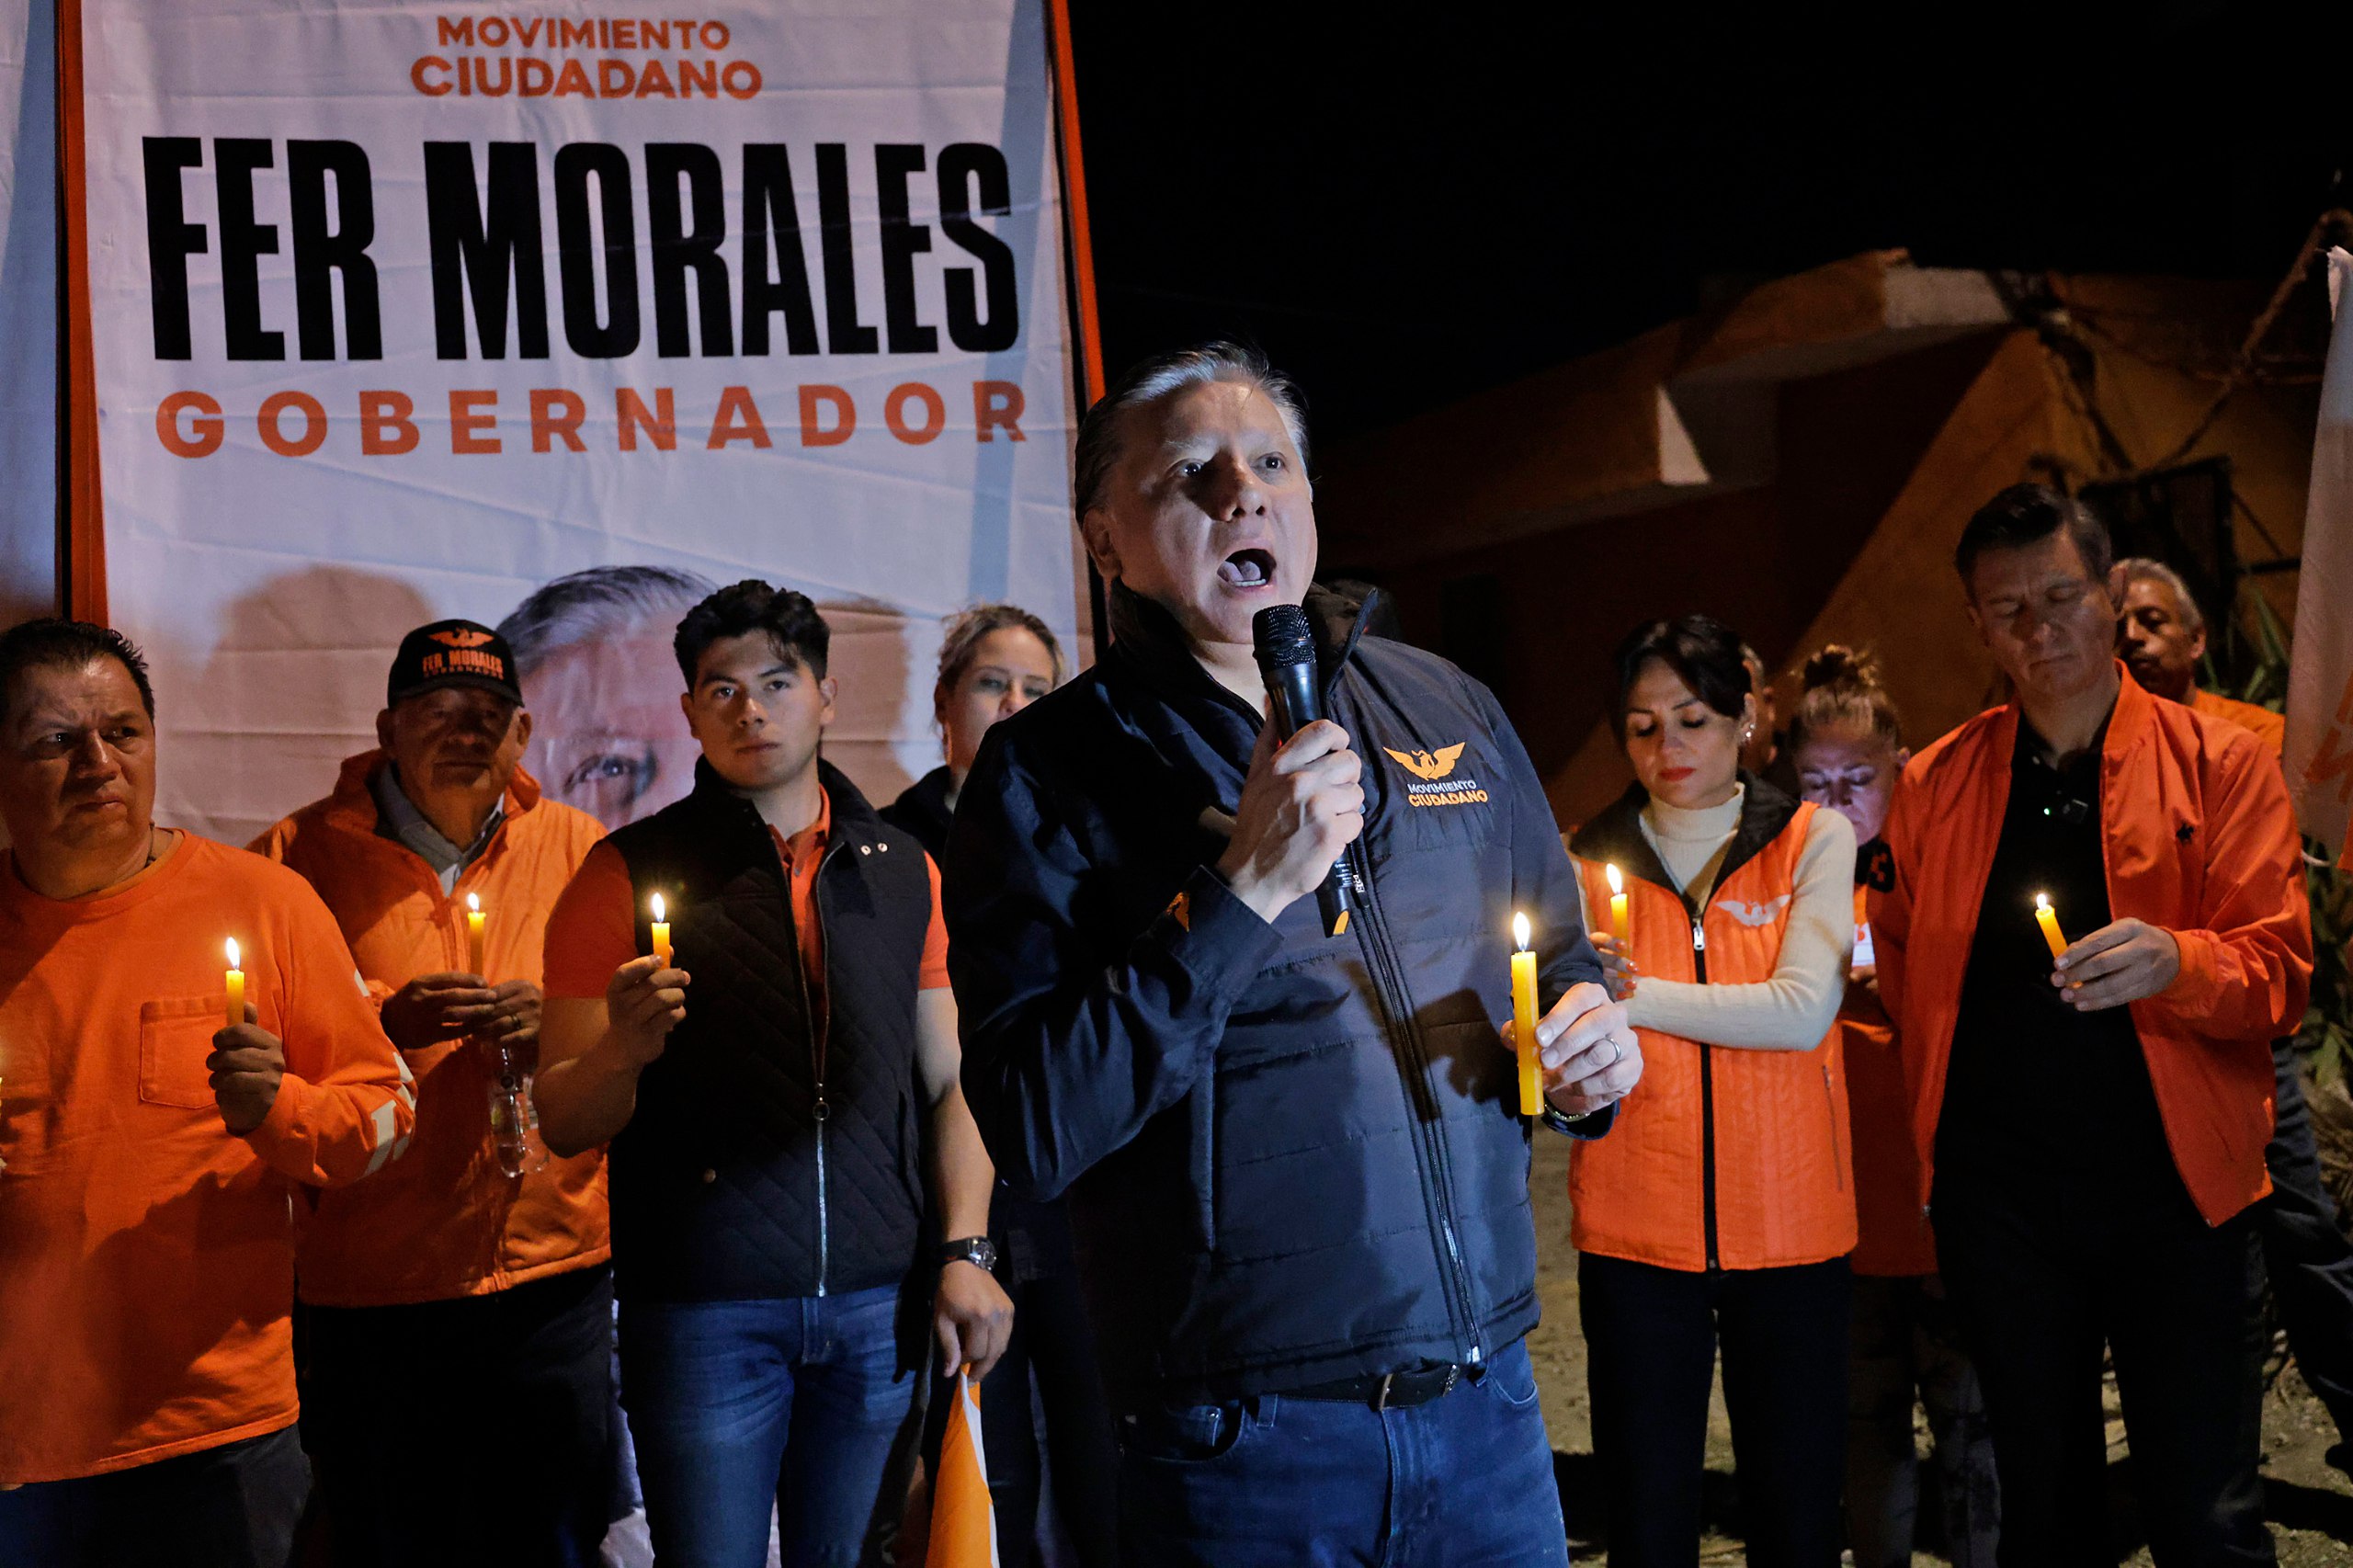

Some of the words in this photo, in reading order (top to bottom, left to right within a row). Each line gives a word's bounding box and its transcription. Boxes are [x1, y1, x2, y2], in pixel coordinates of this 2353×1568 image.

[437, 17, 731, 51] MOVIMIENTO
[411, 55, 763, 100] CIUDADANO
[142, 136, 382, 360] FER
[424, 142, 1019, 360] MORALES
[155, 381, 1027, 460] GOBERNADOR
[1407, 779, 1477, 794] MOVIMIENTO
[1407, 790, 1489, 807] CIUDADANO
